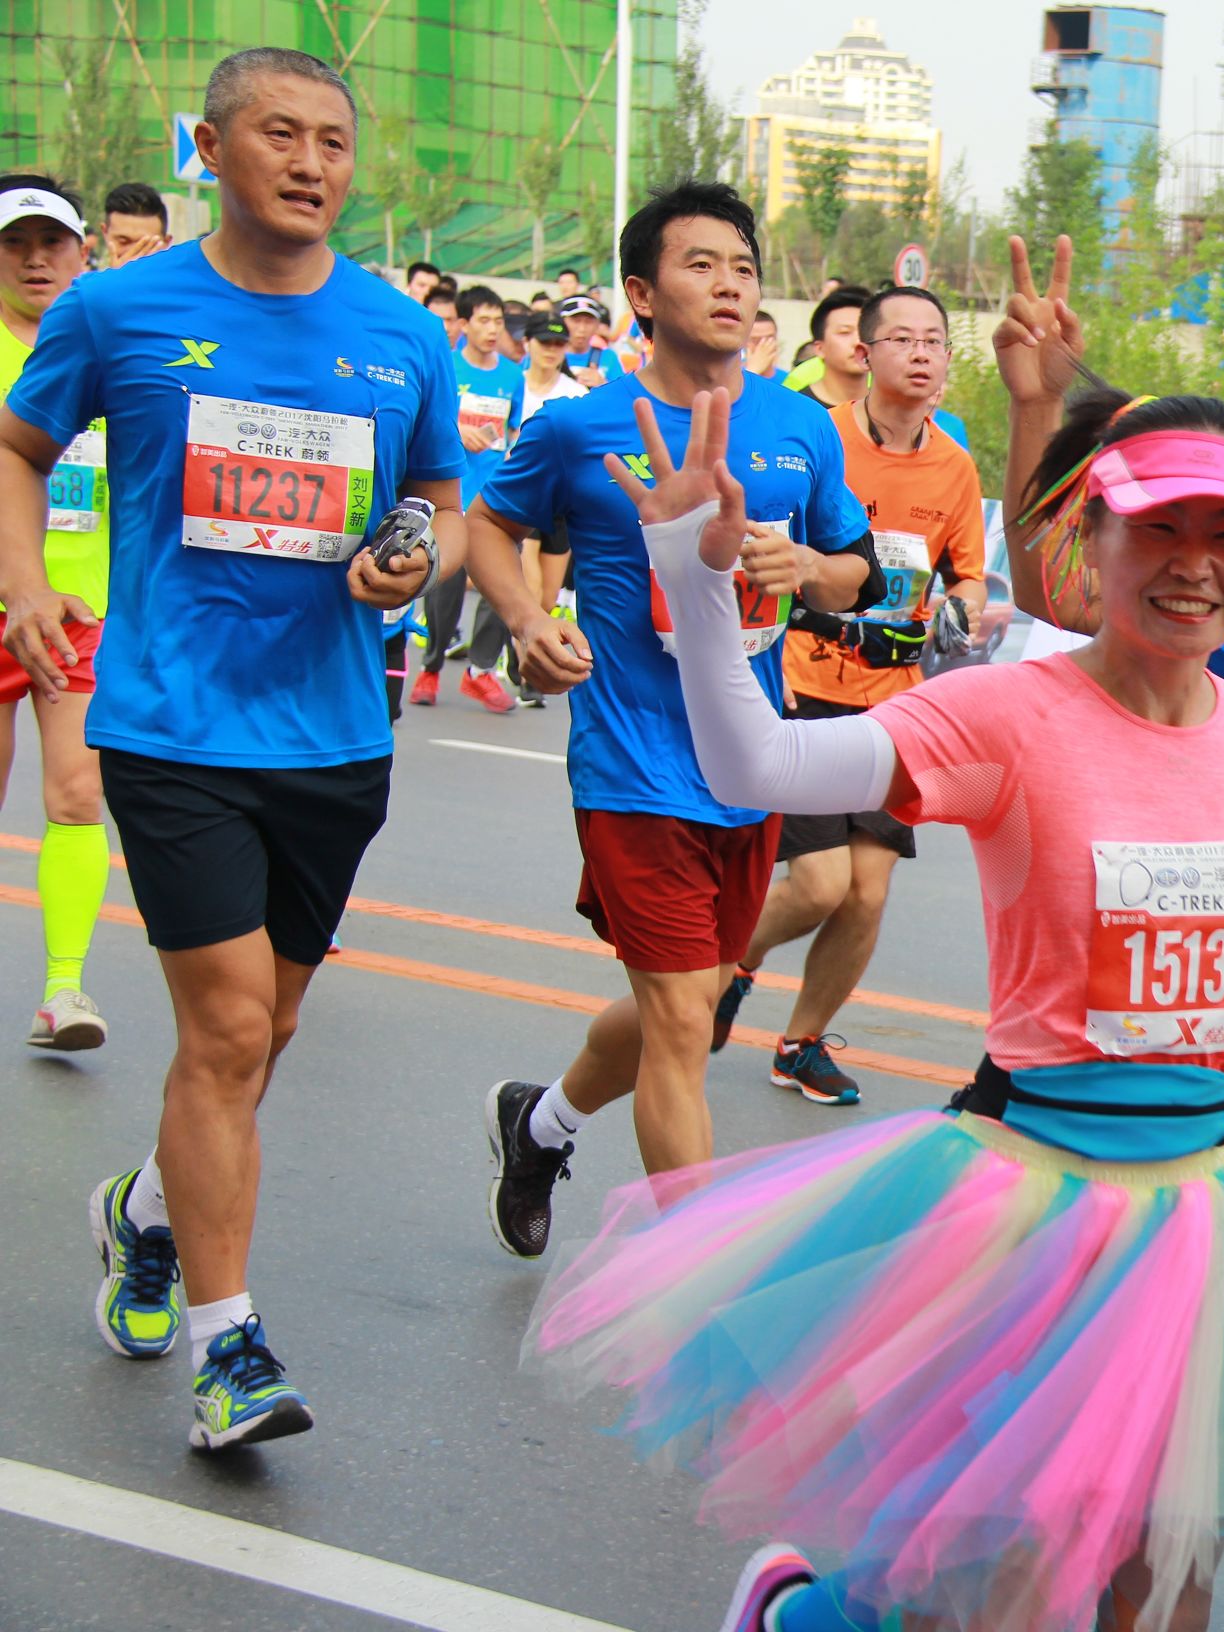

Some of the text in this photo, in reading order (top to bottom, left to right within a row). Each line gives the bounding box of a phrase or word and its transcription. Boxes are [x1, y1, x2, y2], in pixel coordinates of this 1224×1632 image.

[904, 259, 920, 281] 30
[237, 440, 294, 458] C-TREK
[209, 463, 325, 523] 11237
[350, 476, 368, 527] 刘又新
[1157, 895, 1224, 911] C-TREK
